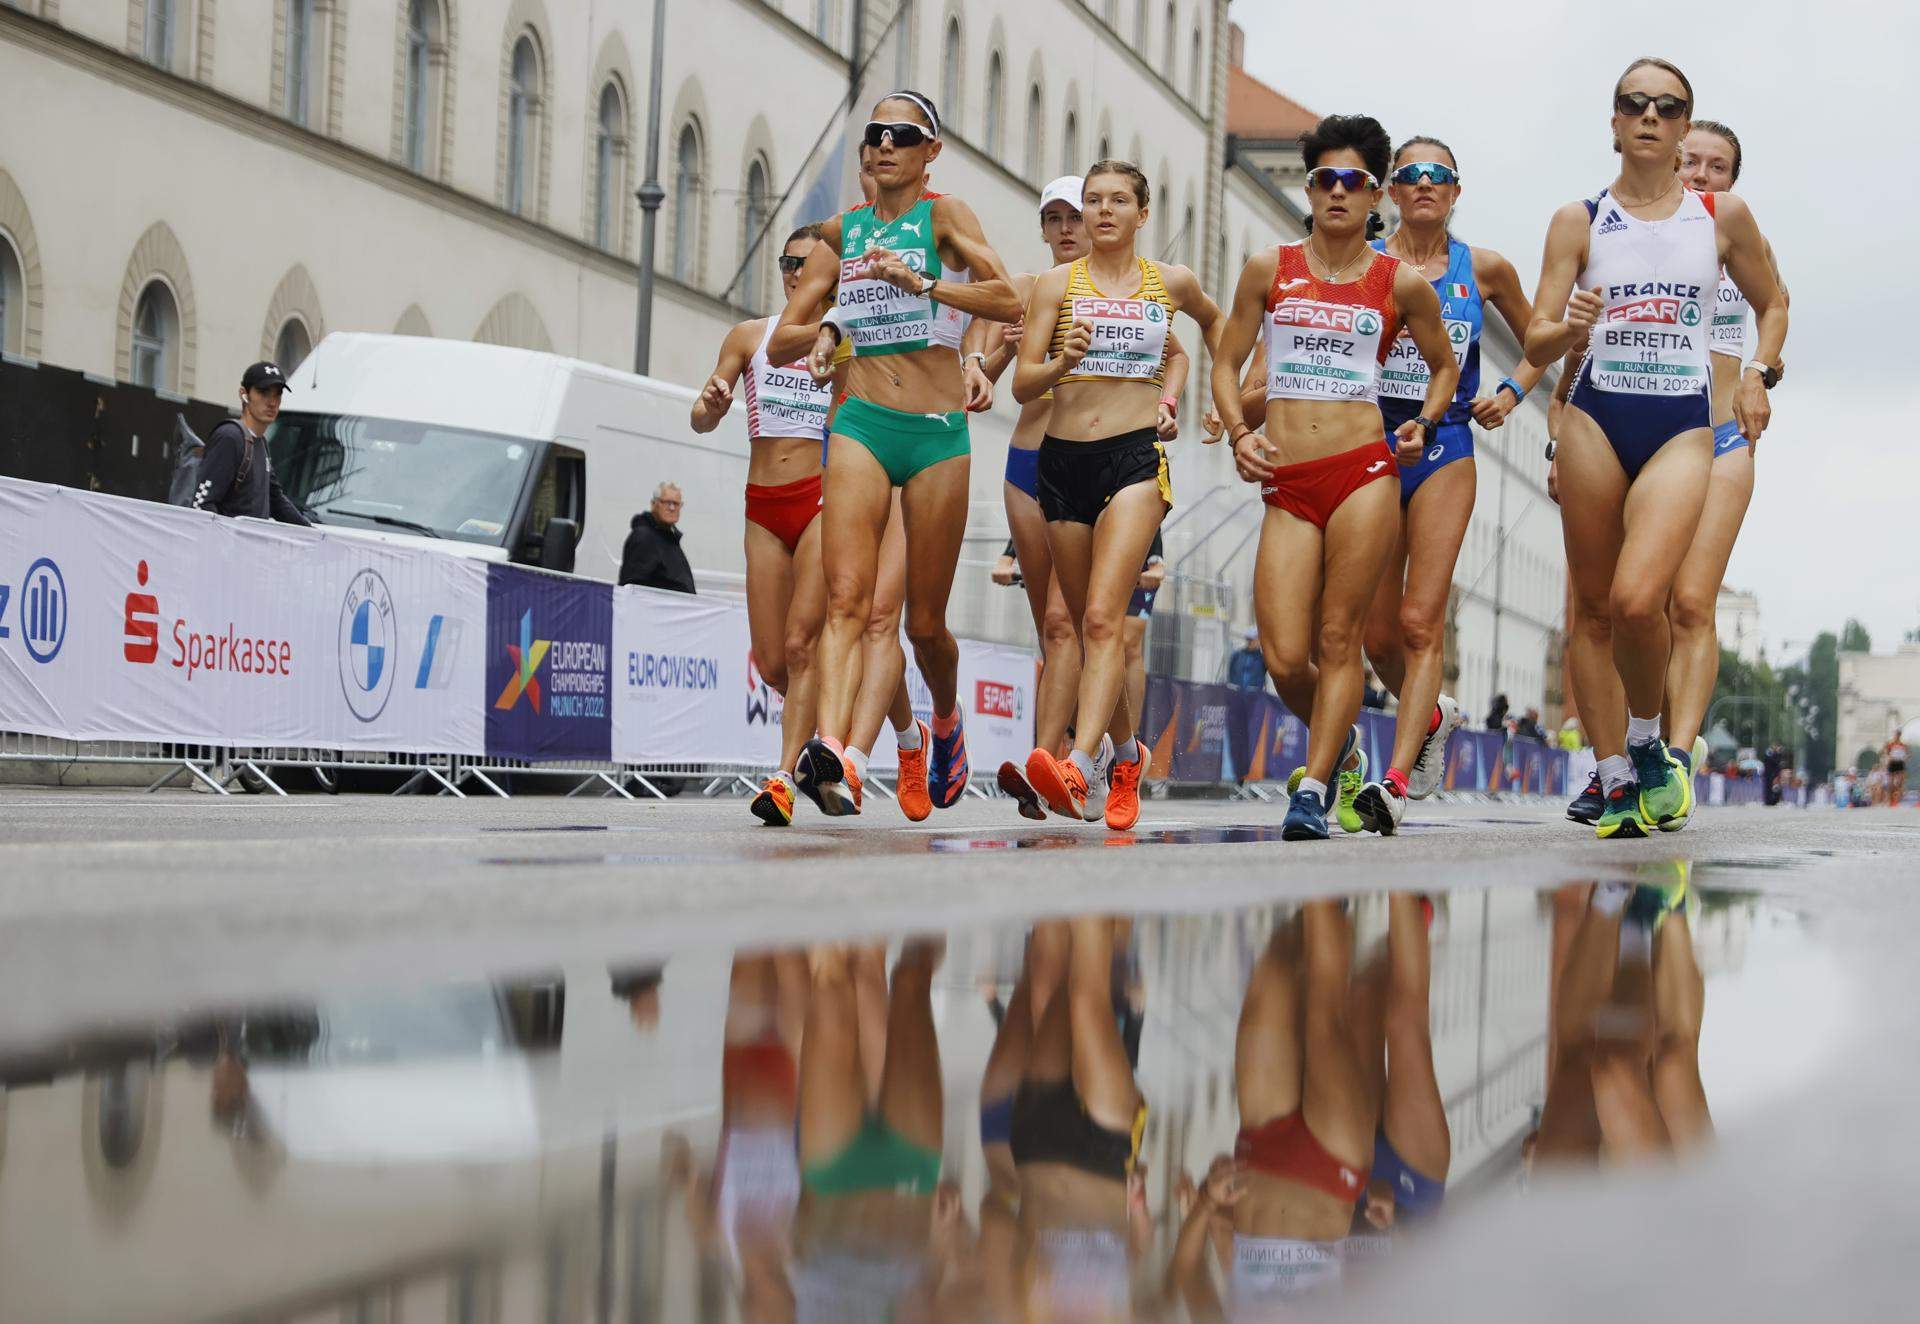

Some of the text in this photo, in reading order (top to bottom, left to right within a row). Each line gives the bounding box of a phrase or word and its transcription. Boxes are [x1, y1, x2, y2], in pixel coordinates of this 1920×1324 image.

[1598, 223, 1628, 235] adidas
[839, 285, 919, 306] CABECIN
[1609, 282, 1701, 299] FRANCE
[870, 304, 888, 316] 131
[1076, 301, 1142, 318] SPAR
[1274, 306, 1352, 329] SPAR
[851, 323, 929, 343] MUNICH 2022
[1096, 325, 1145, 341] FEIGE
[1605, 330, 1693, 351] BERETTA
[1719, 327, 1742, 340] 2022
[1111, 342, 1130, 351] 116
[1293, 334, 1355, 357] PÉREZ
[1309, 353, 1332, 366] 106
[1639, 350, 1659, 363] 111
[1076, 360, 1155, 376] MUNICH 2022
[1294, 364, 1314, 373] RUN
[1406, 363, 1426, 374] 128
[1624, 362, 1644, 372] RUN
[1275, 375, 1366, 396] MUNICH 2022
[1392, 372, 1411, 381] RUN
[1412, 374, 1430, 383] CLE
[1597, 373, 1699, 392] MUNICH 2022
[793, 392, 811, 402] 130
[762, 403, 828, 426] MUNICH 20
[347, 576, 391, 619] BMW
[172, 618, 292, 681] Sparkasse
[551, 640, 606, 672] EUROPEAN
[550, 672, 605, 694] CHAMPIONSHIPS
[550, 695, 583, 717] MUNICH
[584, 695, 605, 718] 2022
[983, 684, 1013, 713] SPAR
